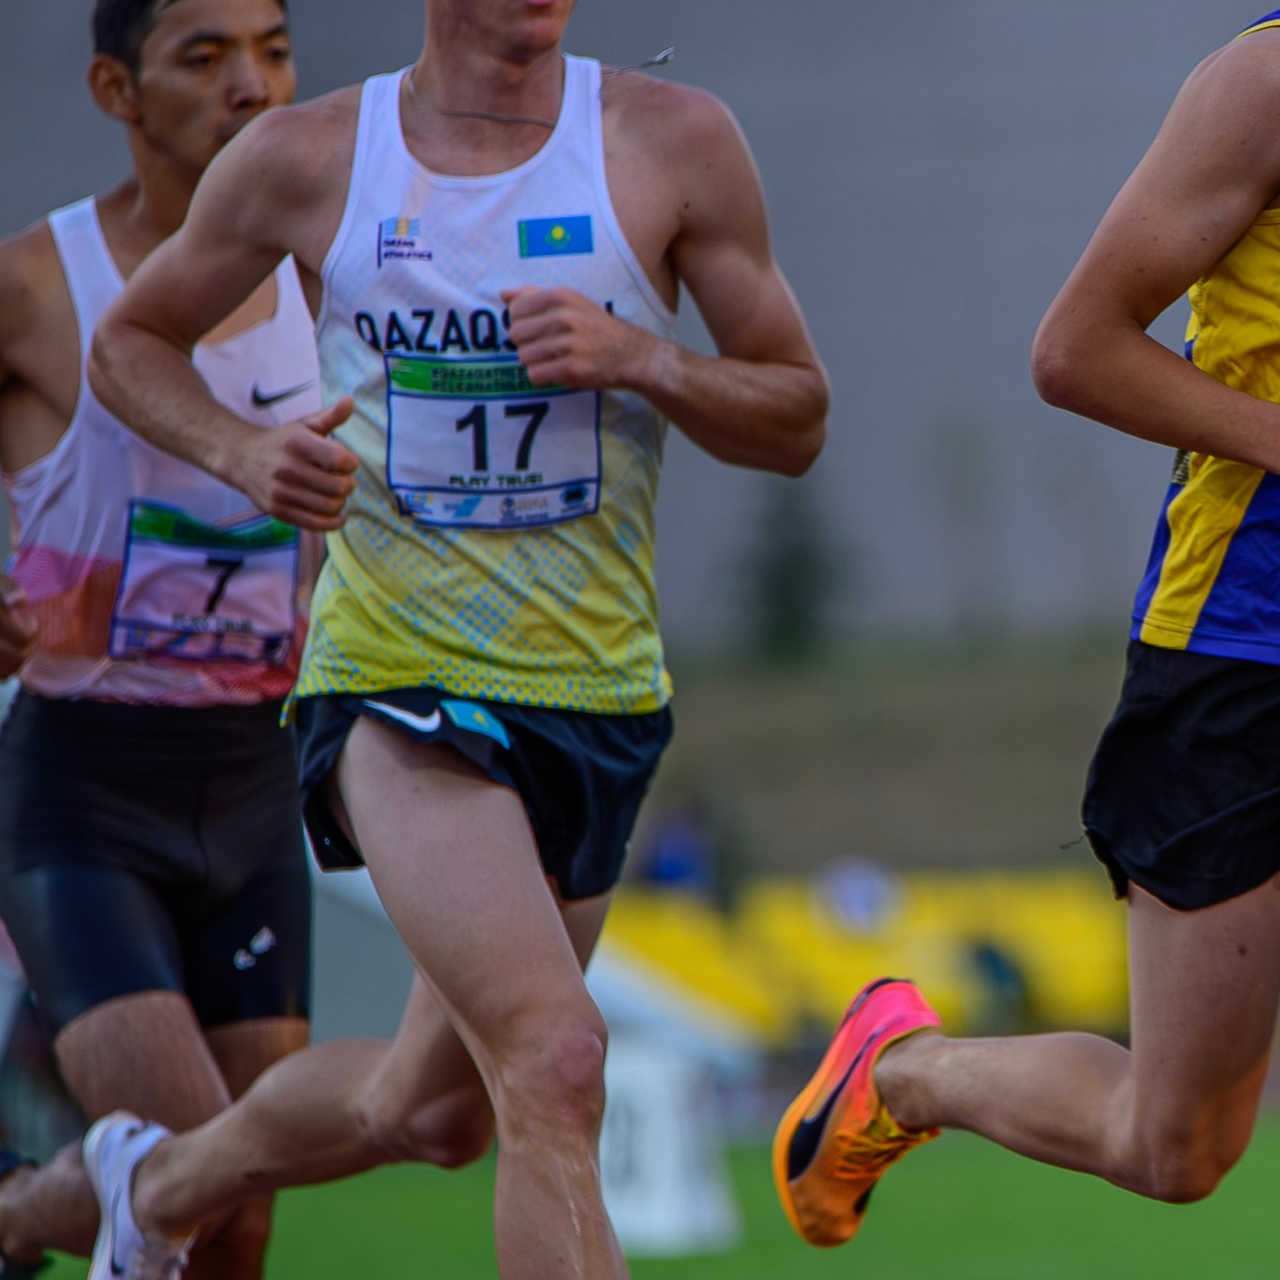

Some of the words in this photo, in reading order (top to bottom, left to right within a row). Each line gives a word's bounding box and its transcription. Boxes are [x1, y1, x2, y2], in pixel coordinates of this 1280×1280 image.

[456, 403, 549, 471] 17
[450, 474, 490, 487] PLAY
[206, 555, 244, 614] 7
